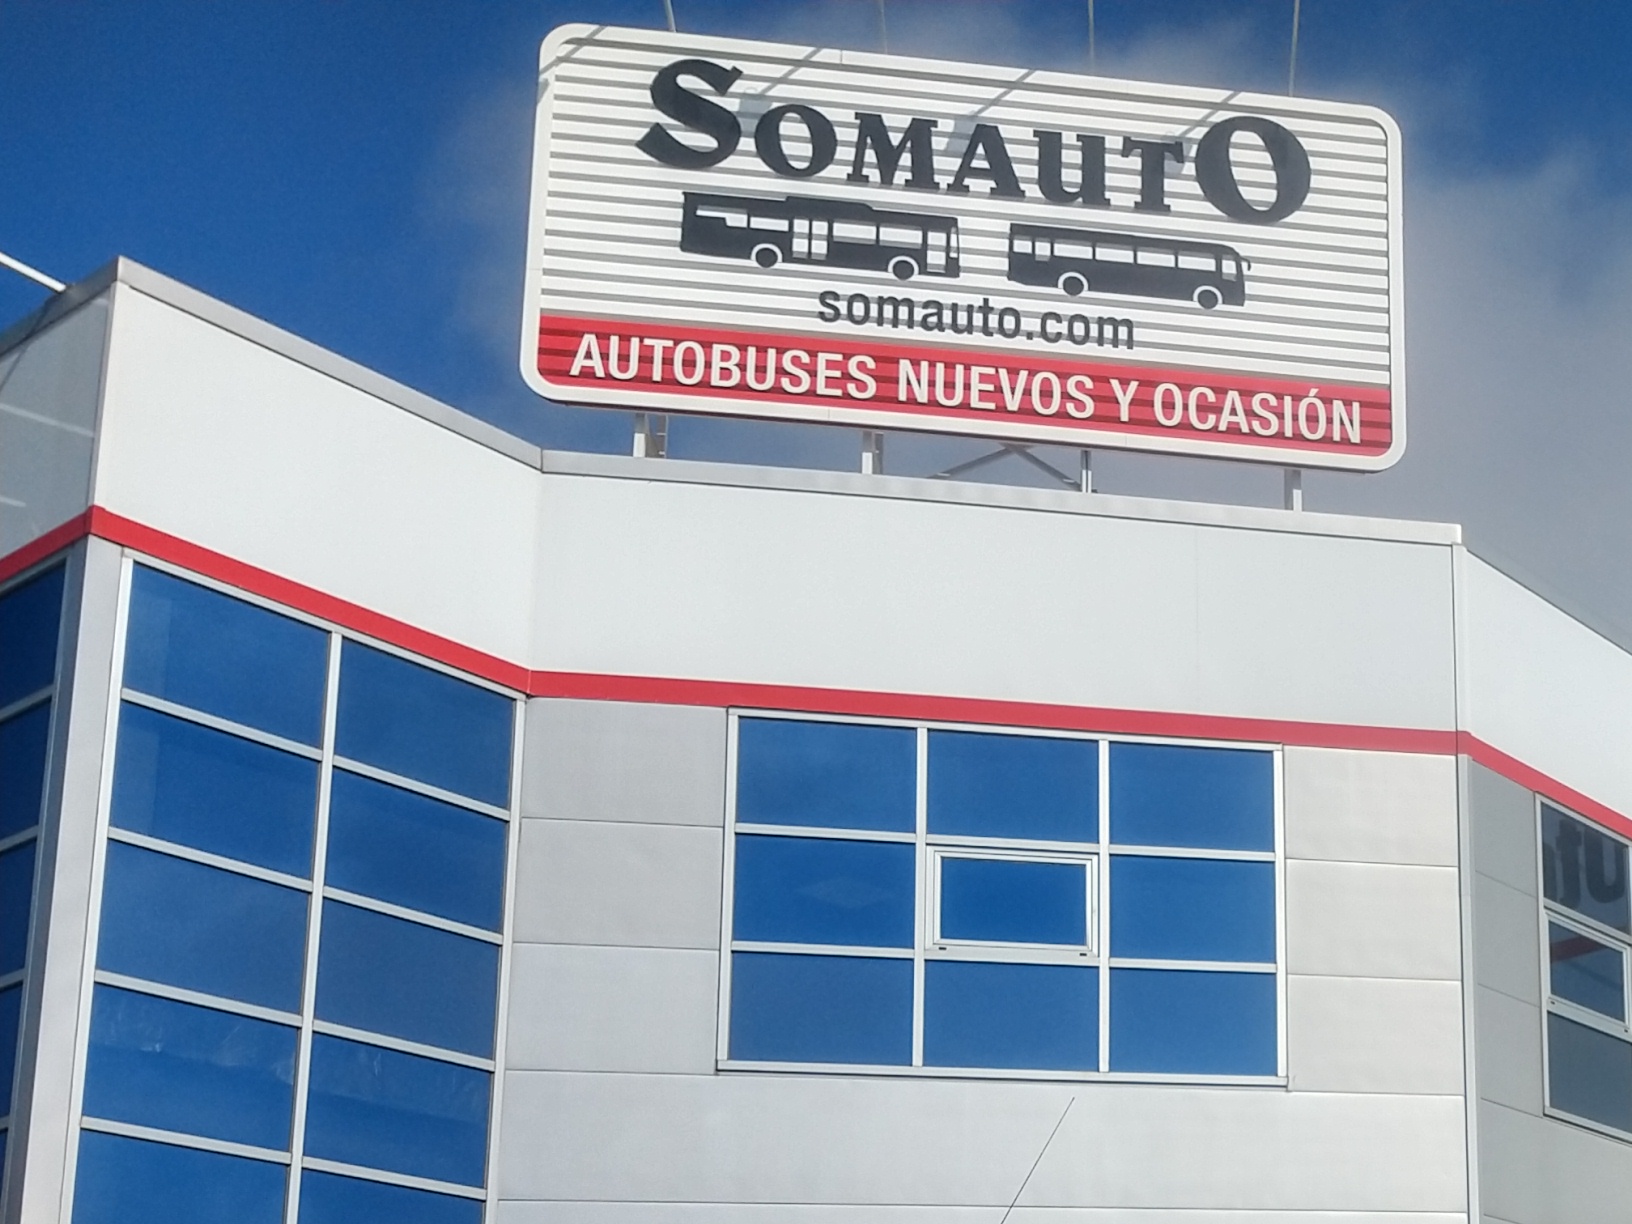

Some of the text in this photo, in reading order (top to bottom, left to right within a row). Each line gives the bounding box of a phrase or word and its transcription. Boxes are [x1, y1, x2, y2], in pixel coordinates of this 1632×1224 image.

[817, 288, 1136, 350] somauto.com
[569, 333, 1362, 445] AUTOBUSES NUEVOS Y OCASIÓN
